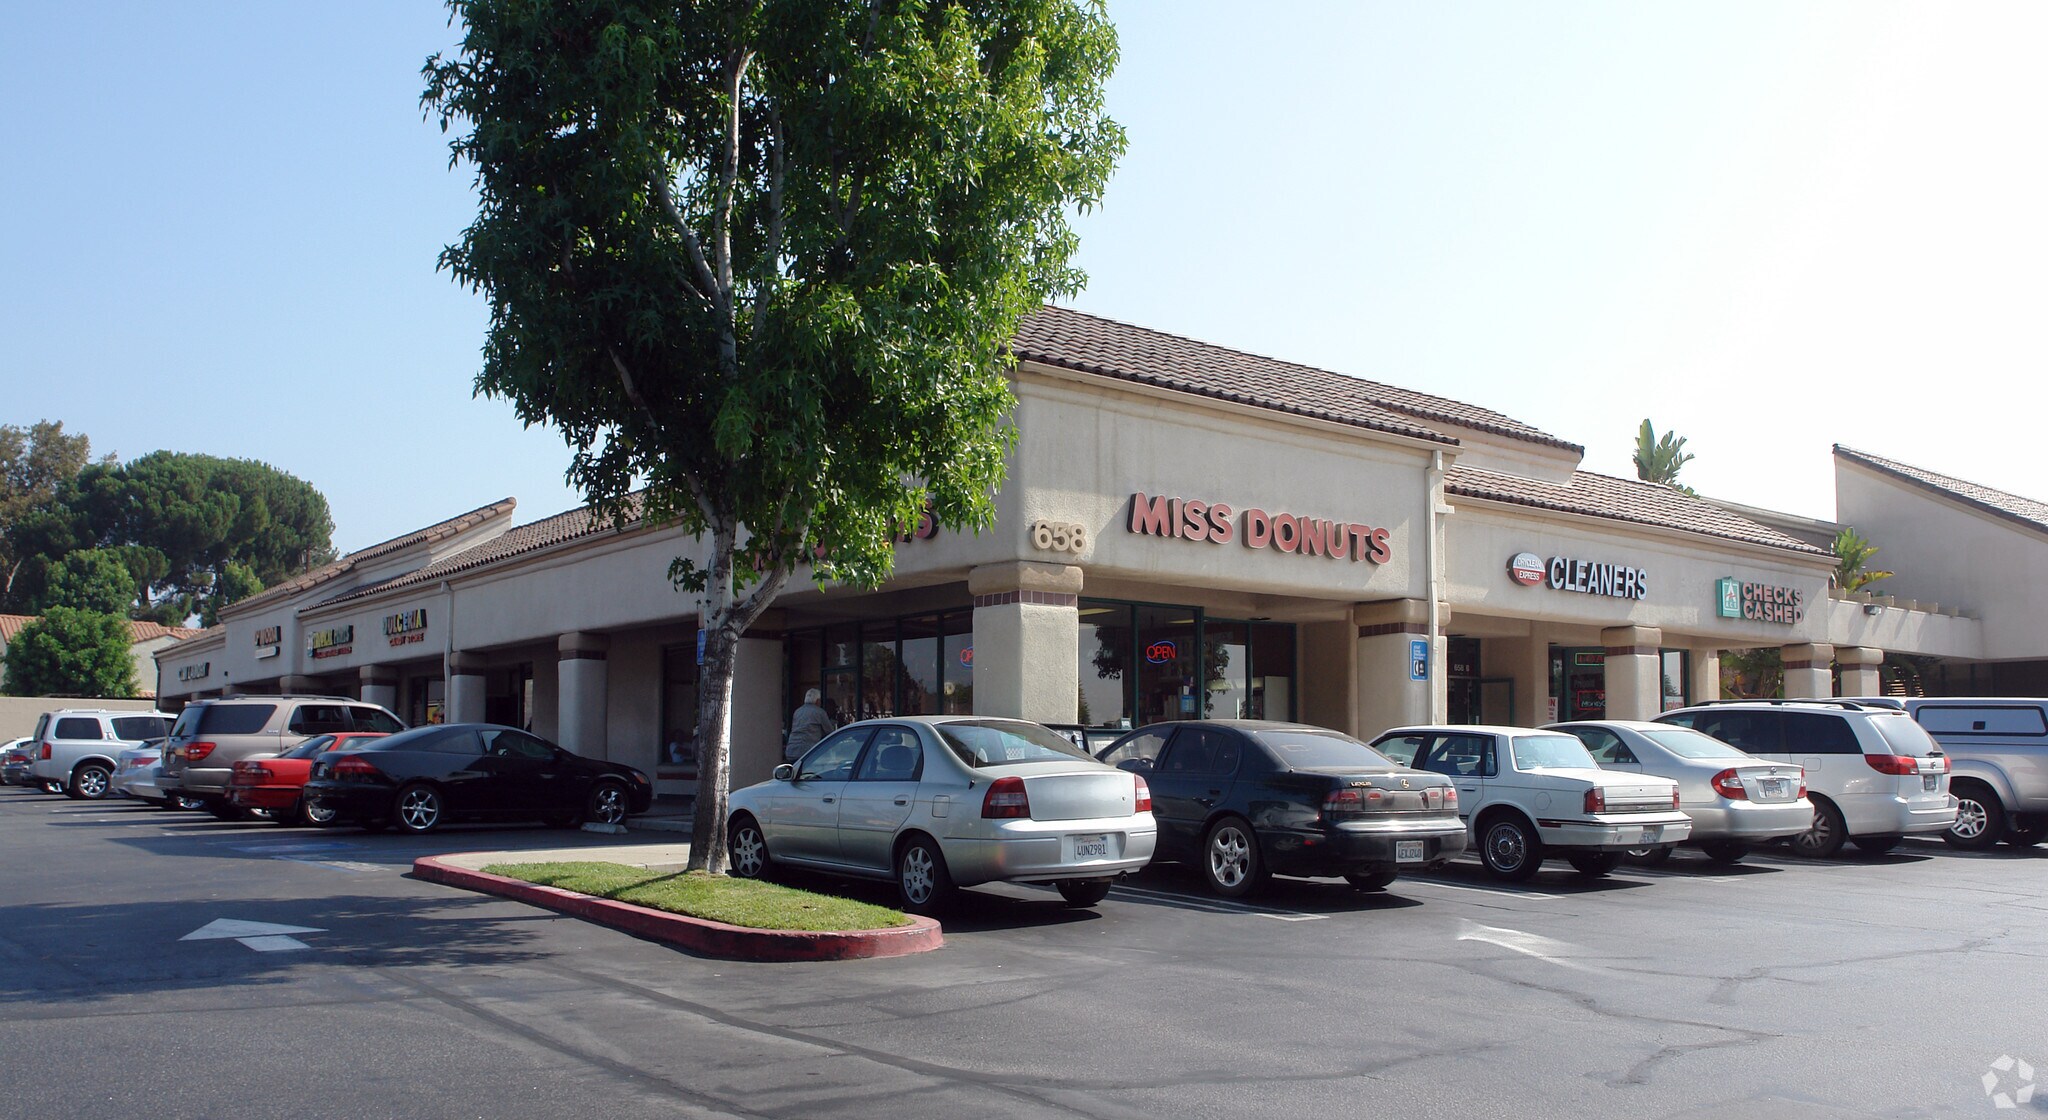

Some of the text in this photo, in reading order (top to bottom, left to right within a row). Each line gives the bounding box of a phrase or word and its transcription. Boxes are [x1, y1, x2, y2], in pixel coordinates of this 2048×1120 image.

[1032, 519, 1087, 553] 658
[1128, 491, 1391, 565] MISS DONUTS
[1519, 570, 1540, 581] EXPRESS
[1546, 555, 1647, 600] CLEANERS
[1741, 582, 1804, 606] CHECKS
[382, 608, 427, 635] DULCERIA
[1742, 600, 1804, 624] CASHED
[960, 648, 973, 662] OP
[1146, 645, 1176, 660] OPEN
[1578, 654, 1605, 664] LOA
